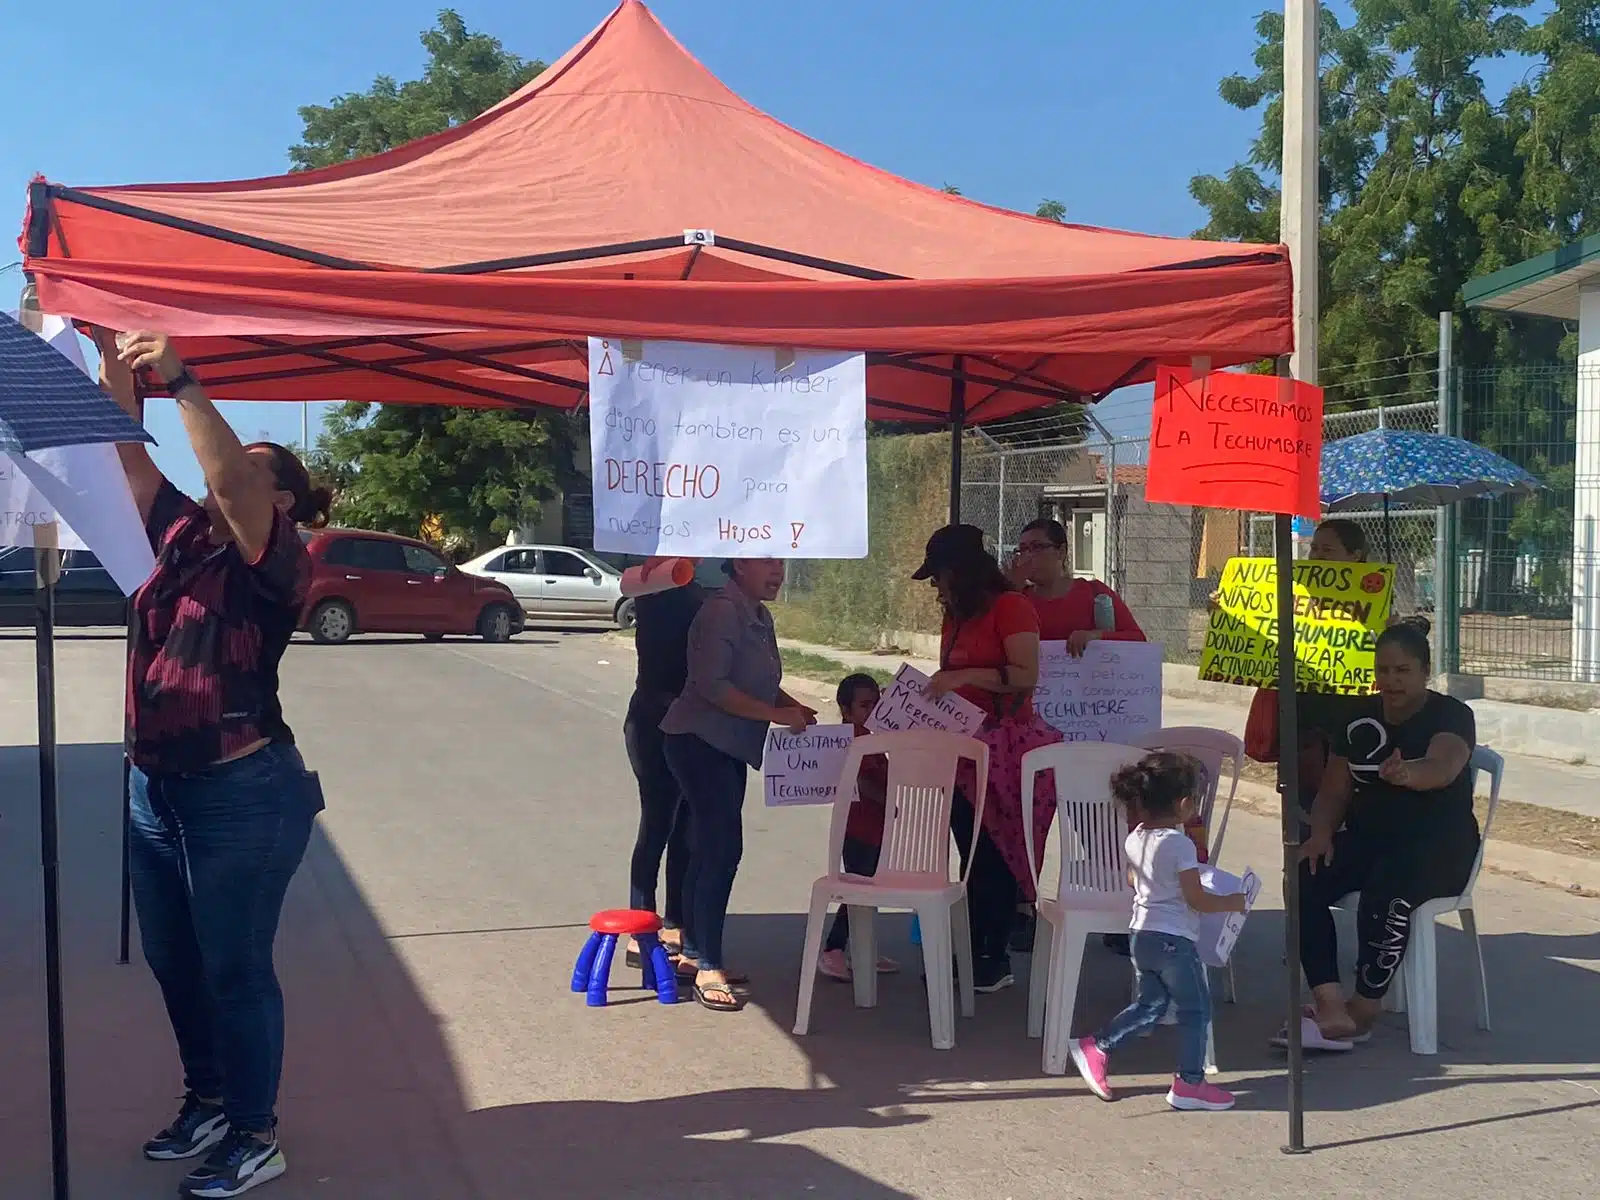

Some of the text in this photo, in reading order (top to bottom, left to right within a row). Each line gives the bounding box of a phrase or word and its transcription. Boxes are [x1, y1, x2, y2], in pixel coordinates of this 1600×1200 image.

[705, 367, 732, 388] un
[1169, 373, 1313, 423] NECESITAMOS
[605, 408, 841, 443] digno tambien es un
[1208, 421, 1313, 458] TECHUMBRE
[605, 458, 788, 500] DERECHO para
[608, 516, 692, 537] nuestros
[1232, 563, 1353, 592] NUETROS
[1219, 585, 1372, 624] NIÑOS ERECEN
[1211, 608, 1376, 653] UNA TEHUMBRE
[1205, 631, 1347, 670] DONDE RELIZAR
[1206, 654, 1375, 684] ACTIVIDADE ESCOLARE
[769, 731, 852, 752] NECESITAMOS
[787, 753, 819, 771] UNA
[1361, 897, 1411, 989] Calvin
